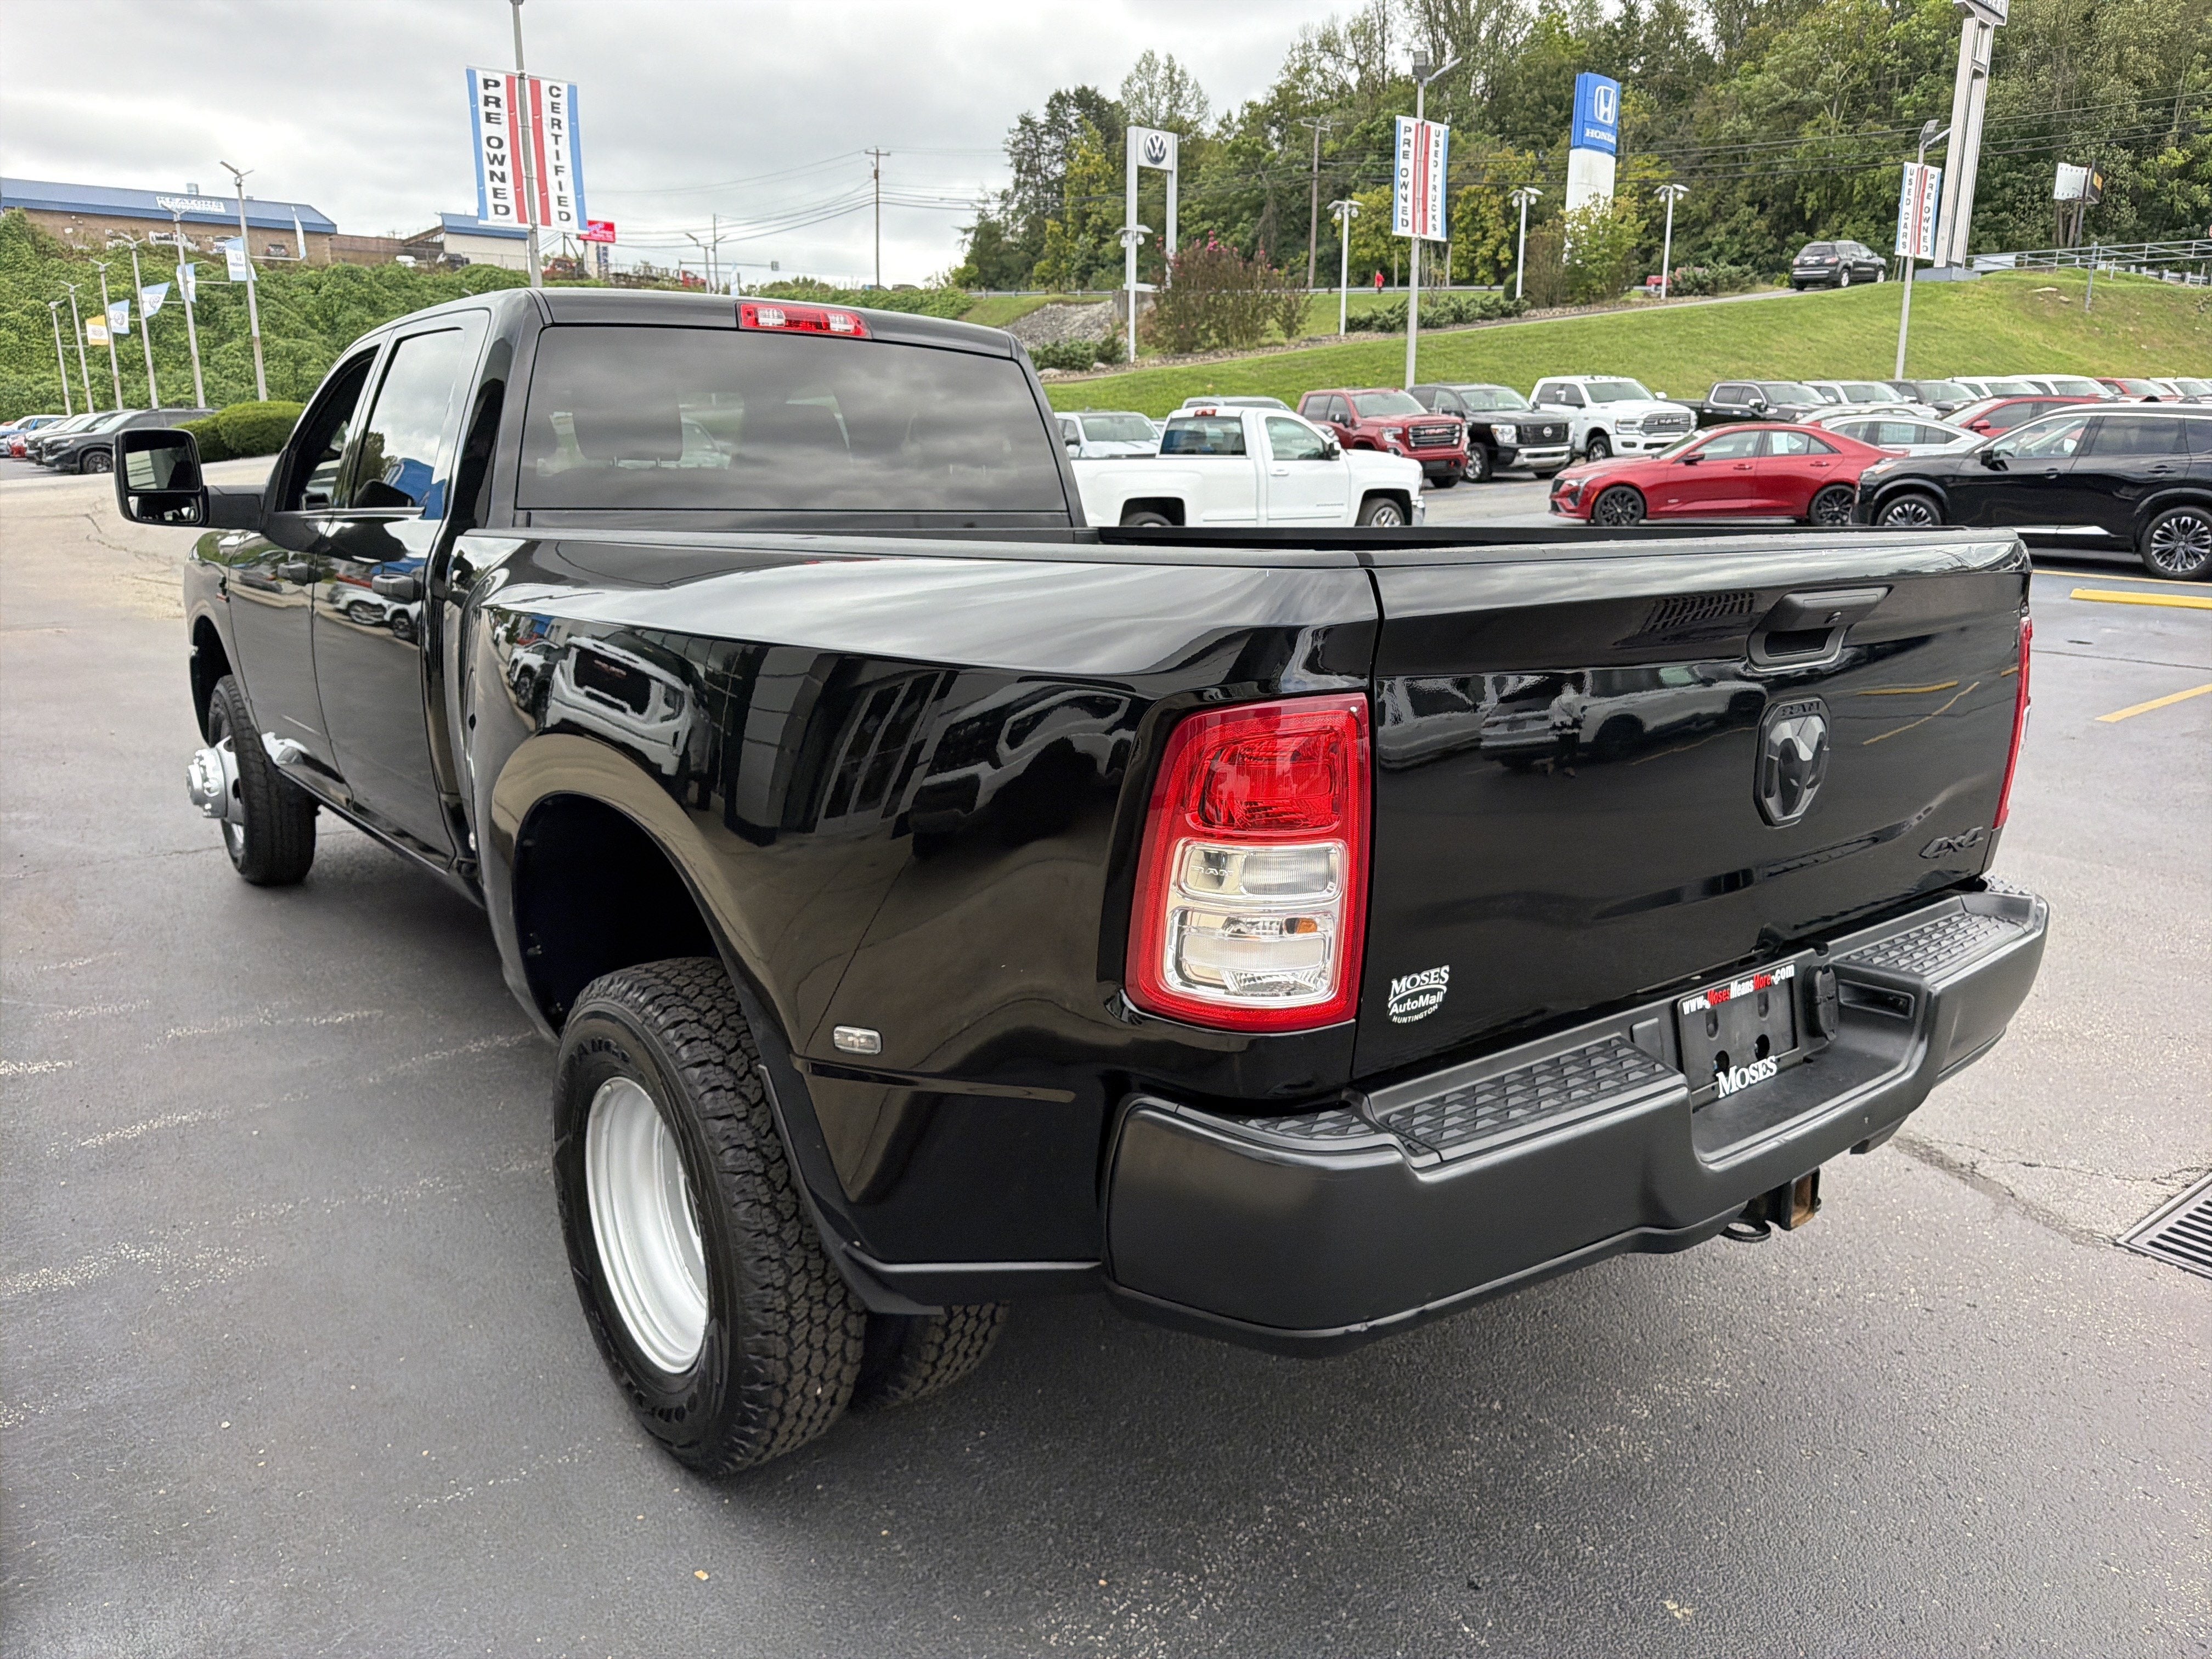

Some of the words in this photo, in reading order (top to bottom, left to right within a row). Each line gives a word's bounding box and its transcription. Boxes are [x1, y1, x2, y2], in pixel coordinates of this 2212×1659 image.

[483, 78, 501, 125] PRE
[548, 85, 571, 222] CERTIFIED
[1402, 126, 1412, 160] PRE
[486, 135, 510, 216] OWNED
[1905, 168, 1915, 206] USED
[1926, 173, 1936, 200] PRE
[1400, 167, 1409, 228] OWNED
[1901, 212, 1910, 250] CARS
[1922, 206, 1931, 252] OWNED
[1389, 965, 1450, 1002] MOSES
[1389, 991, 1443, 1016] AutoMall
[1392, 1004, 1438, 1024] HUNTINGTON
[1716, 1056, 1778, 1098] MOSES
